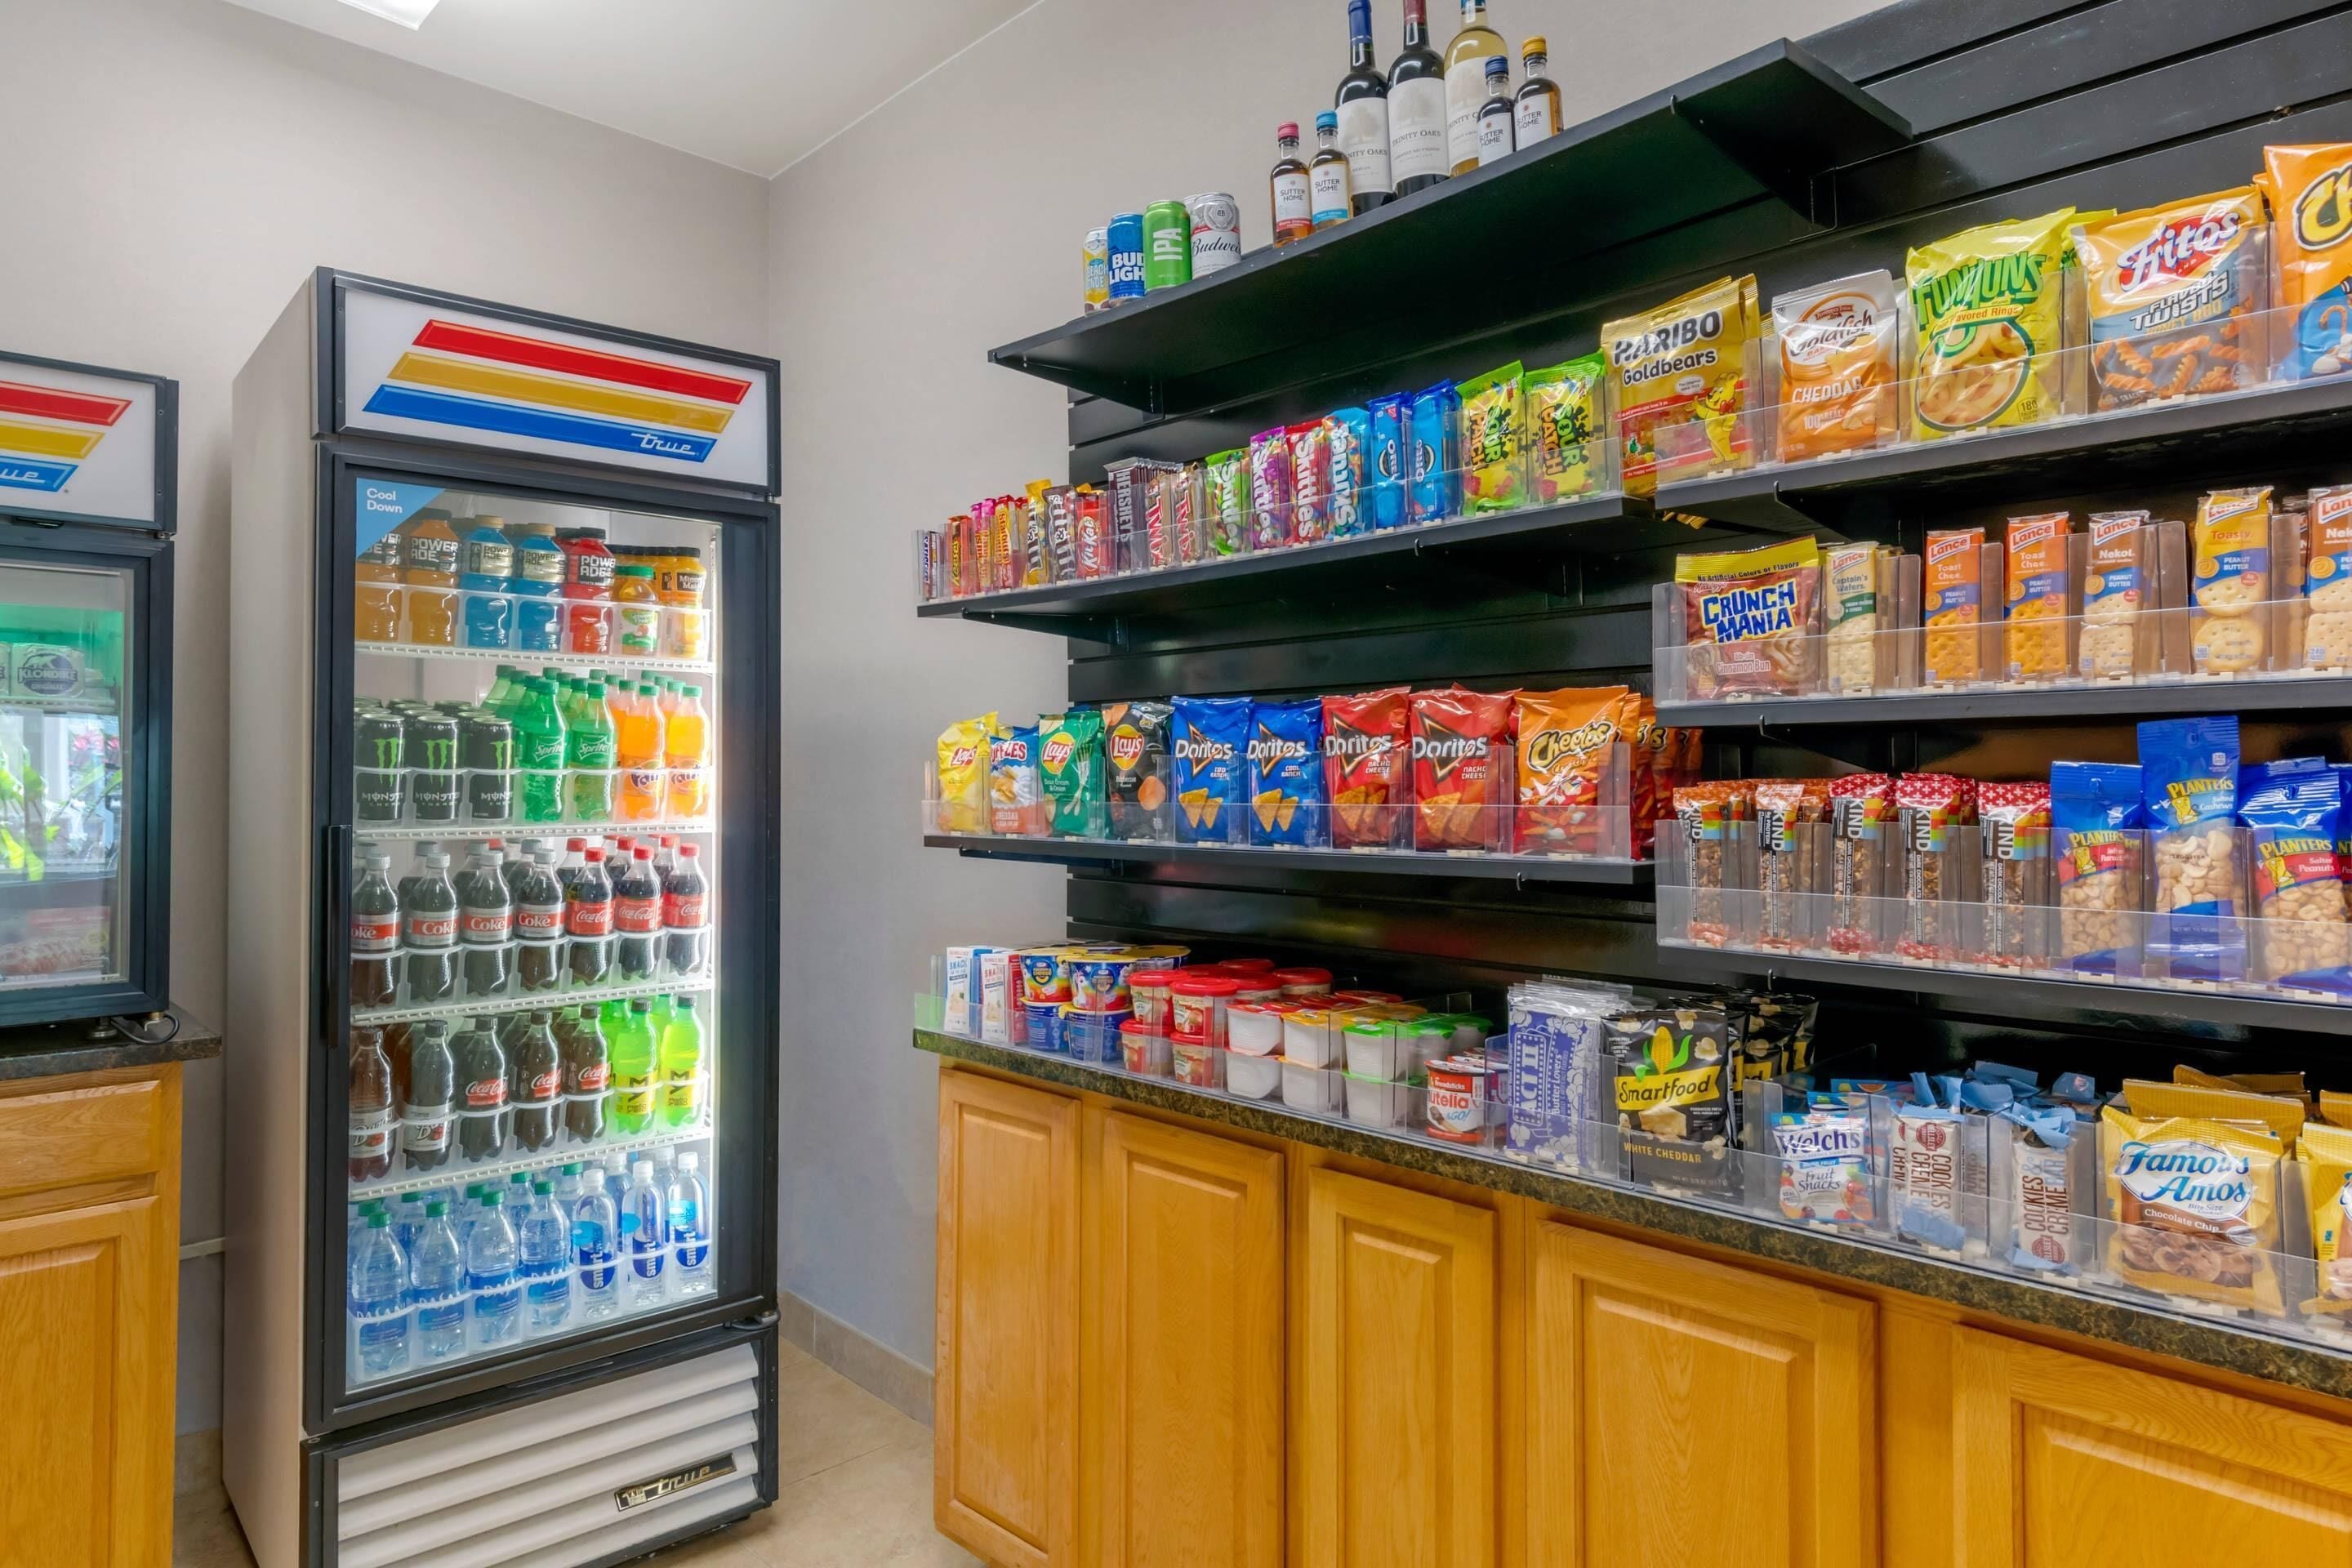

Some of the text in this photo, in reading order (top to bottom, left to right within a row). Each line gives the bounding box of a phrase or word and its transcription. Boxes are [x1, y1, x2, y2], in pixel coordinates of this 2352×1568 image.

[1517, 110, 1542, 126] SUTTER
[1518, 118, 1540, 131] HOME
[1392, 131, 1419, 147] TRINITY
[1419, 130, 1441, 138] OAKS
[1479, 129, 1503, 143] SUTTER
[1481, 136, 1502, 147] HOME
[1367, 148, 1388, 156] OAKS
[1281, 189, 1305, 197] SUTTER
[1315, 179, 1340, 189] SUTTER
[1152, 228, 1183, 261] IPA
[1192, 237, 1241, 256] Budwei
[2117, 212, 2240, 292] Fritos
[1109, 266, 1144, 285] LIGH
[1913, 252, 2047, 335] FUNYUNS
[2130, 270, 2229, 330] TWISTS
[1991, 305, 2020, 317] Rings
[2193, 301, 2222, 323] BBQ
[1614, 310, 1722, 365] HARIBO
[1624, 350, 1716, 385] Goldbears
[1792, 376, 1864, 403] CHEDDAR
[630, 432, 697, 456] true
[1471, 412, 1488, 473] PATCH
[1484, 406, 1503, 462] SOUR
[1540, 405, 1564, 475] PATCH
[1556, 404, 1582, 466] SOUR
[367, 488, 396, 503] Cool
[1253, 448, 1274, 545] Skittles
[1295, 437, 1314, 538] Skittles
[367, 499, 403, 514] Down
[1116, 471, 1133, 543] HERSHEY'S
[2322, 493, 2352, 516] Lan
[2012, 524, 2051, 546] Lance
[2096, 519, 2137, 539] Lance
[2212, 531, 2252, 541] Toasty
[2326, 528, 2352, 539] Nek
[411, 537, 459, 552] POWER
[483, 545, 513, 555] POWER
[1931, 537, 1967, 558] Lance
[411, 549, 439, 562] ADE
[525, 551, 556, 561] POWER
[1833, 550, 1865, 571] Lance
[2020, 551, 2046, 560] Toast
[1708, 573, 1737, 582] Artificial
[1739, 568, 1762, 578] Colors
[1773, 561, 1799, 572] Flavors
[1937, 564, 1962, 572] Toast
[2109, 573, 2132, 581] PEANUT
[1832, 575, 1869, 586] Captain's
[2029, 579, 2051, 587] PEANUT
[2109, 580, 2131, 588] BUTTER
[1703, 580, 1796, 626] CRUNCH
[1945, 590, 1966, 599] PEANUT
[1716, 607, 1793, 644] MANIA
[18, 668, 78, 684] KLONDIKE
[1717, 658, 1771, 675] Cinnamon Bun
[536, 743, 564, 755] Sprit
[580, 742, 609, 755] Sprite
[991, 741, 1027, 761] UFFLES
[1043, 741, 1074, 762] Lay's
[1112, 736, 1143, 759] Lay's
[1175, 739, 1233, 759] Doritos
[1246, 738, 1307, 760] Doritos
[1325, 734, 1393, 757] Doritos
[1412, 736, 1489, 760] Doritos
[1529, 721, 1614, 769] Cheetos
[1365, 766, 1391, 774] CHEESE
[2168, 778, 2235, 800] PLANTERS
[2199, 802, 2234, 812] Cashews
[2212, 795, 2234, 804] Salted
[1847, 800, 1864, 839] KIND
[1771, 809, 1785, 851] KIND
[1915, 808, 1931, 852] KIND
[2069, 831, 2124, 848] PLANTERS
[1998, 821, 2015, 860] IND
[2259, 839, 2333, 858] PLANTERS
[2298, 862, 2334, 872] Peanuts
[422, 921, 457, 936] Coke
[470, 917, 506, 931] Coke
[519, 913, 551, 928] Coke
[352, 926, 377, 939] oke
[1521, 1071, 1539, 1116] ACT
[1552, 1054, 1562, 1115] Butter Lovers
[1619, 1074, 1712, 1104] Smartfood
[1430, 1092, 1470, 1110] utella
[1777, 1128, 1861, 1155] Welchs
[1623, 1142, 1703, 1165] WHITE CHEDDAR
[2114, 1141, 2250, 1176] Famous
[1798, 1180, 1841, 1193] Snacks
[2140, 1176, 2247, 1203] Amos
[2022, 1174, 2047, 1232] COOKIES
[2206, 1204, 2224, 1212] Size
[2144, 1208, 2220, 1234] Chocolate Chip
[644, 1240, 657, 1277] smart
[684, 1231, 697, 1267] smart
